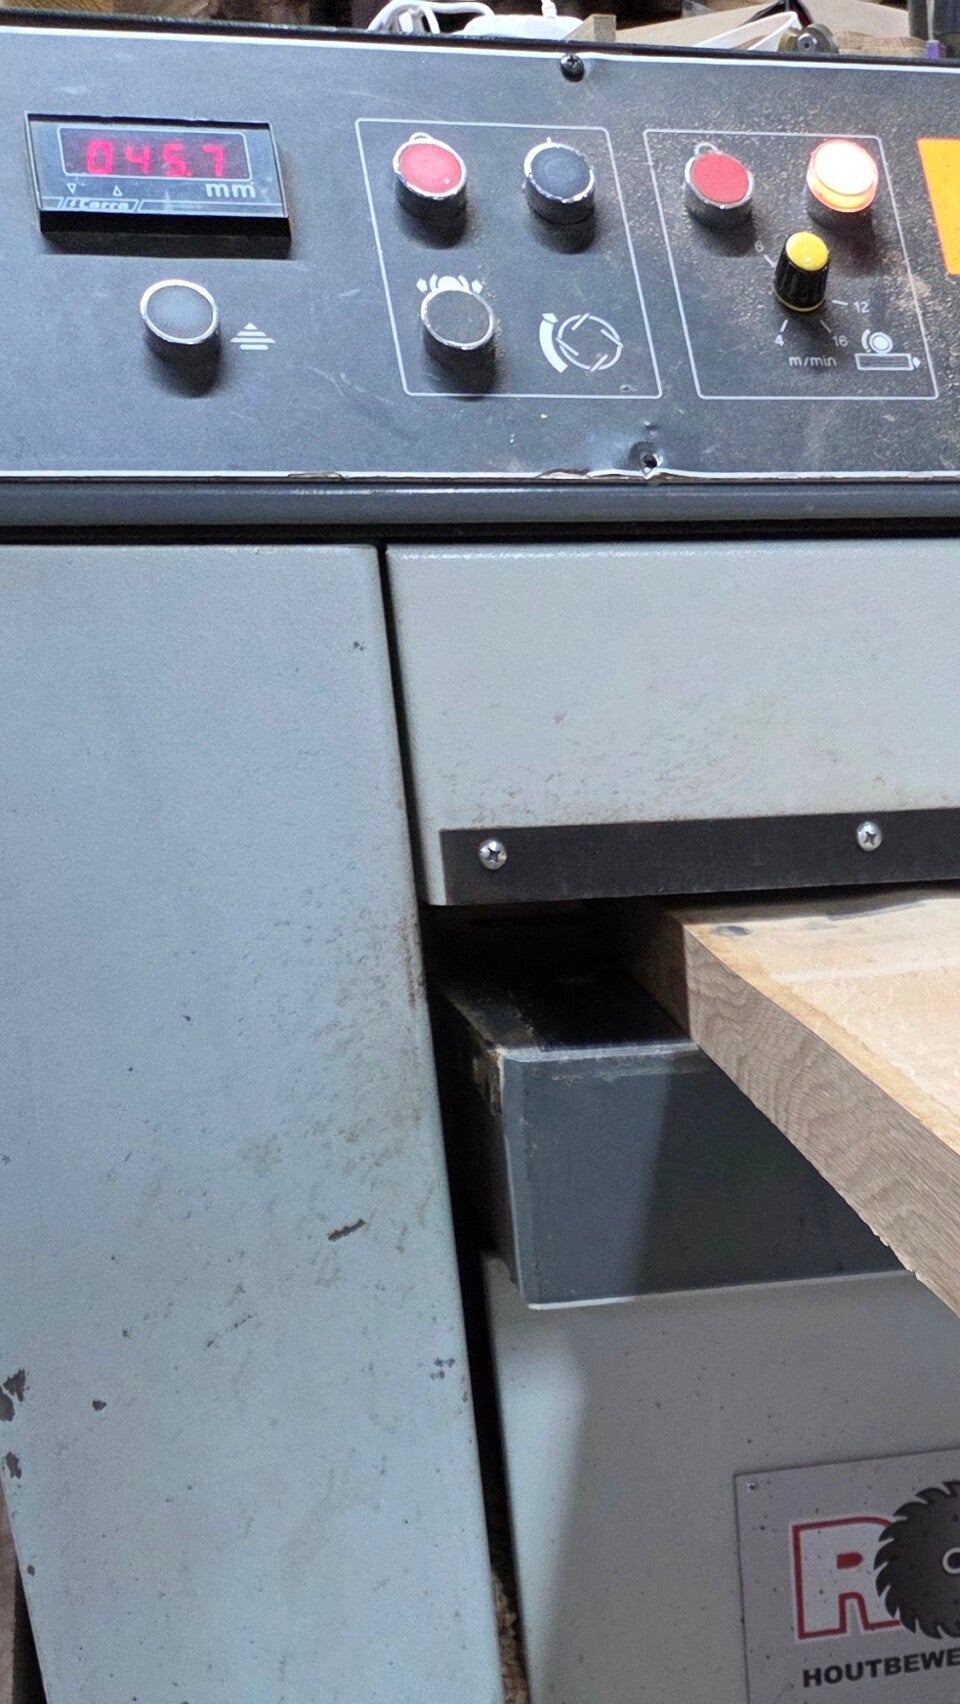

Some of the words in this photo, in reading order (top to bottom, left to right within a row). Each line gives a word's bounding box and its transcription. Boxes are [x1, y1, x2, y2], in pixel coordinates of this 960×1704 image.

[204, 182, 257, 199] mm
[853, 301, 871, 314] 12
[774, 334, 785, 347] 4
[788, 355, 838, 367] m/min
